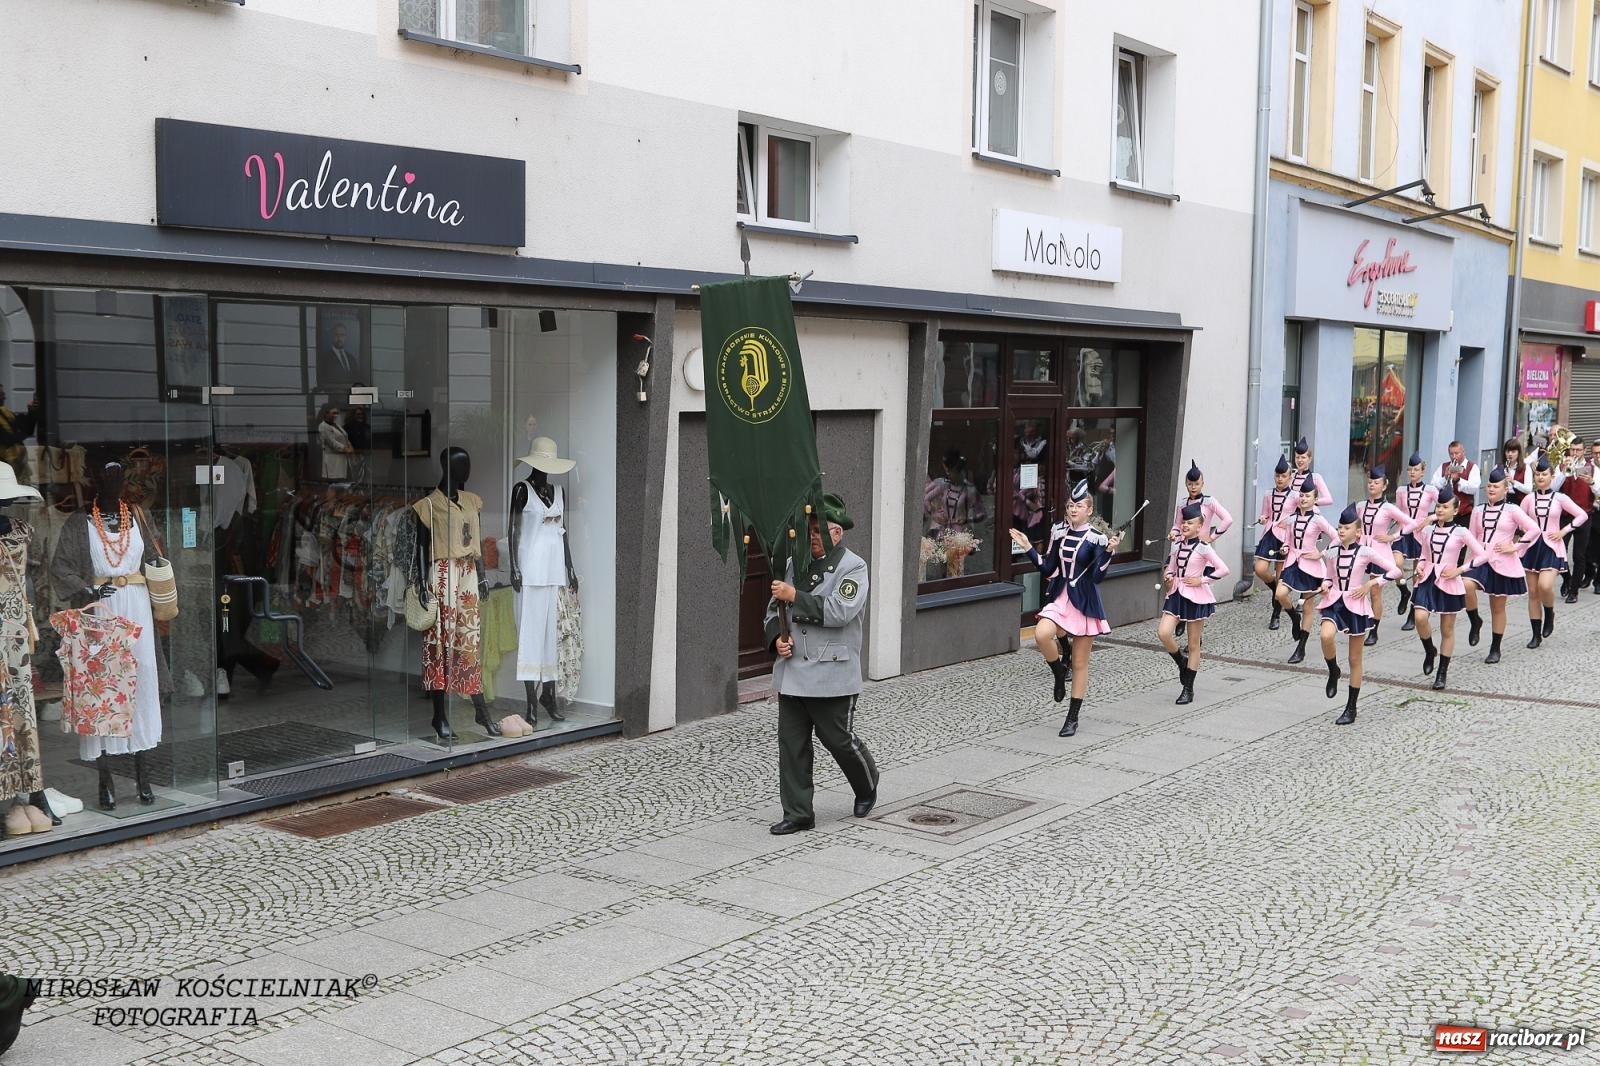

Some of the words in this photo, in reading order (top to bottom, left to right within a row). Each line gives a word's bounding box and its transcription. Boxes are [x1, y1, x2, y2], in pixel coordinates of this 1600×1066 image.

[245, 150, 464, 226] Valentina
[759, 333, 786, 369] KURKOWE
[722, 382, 750, 416] BRACTWO
[751, 378, 787, 418] STRZELECKIE
